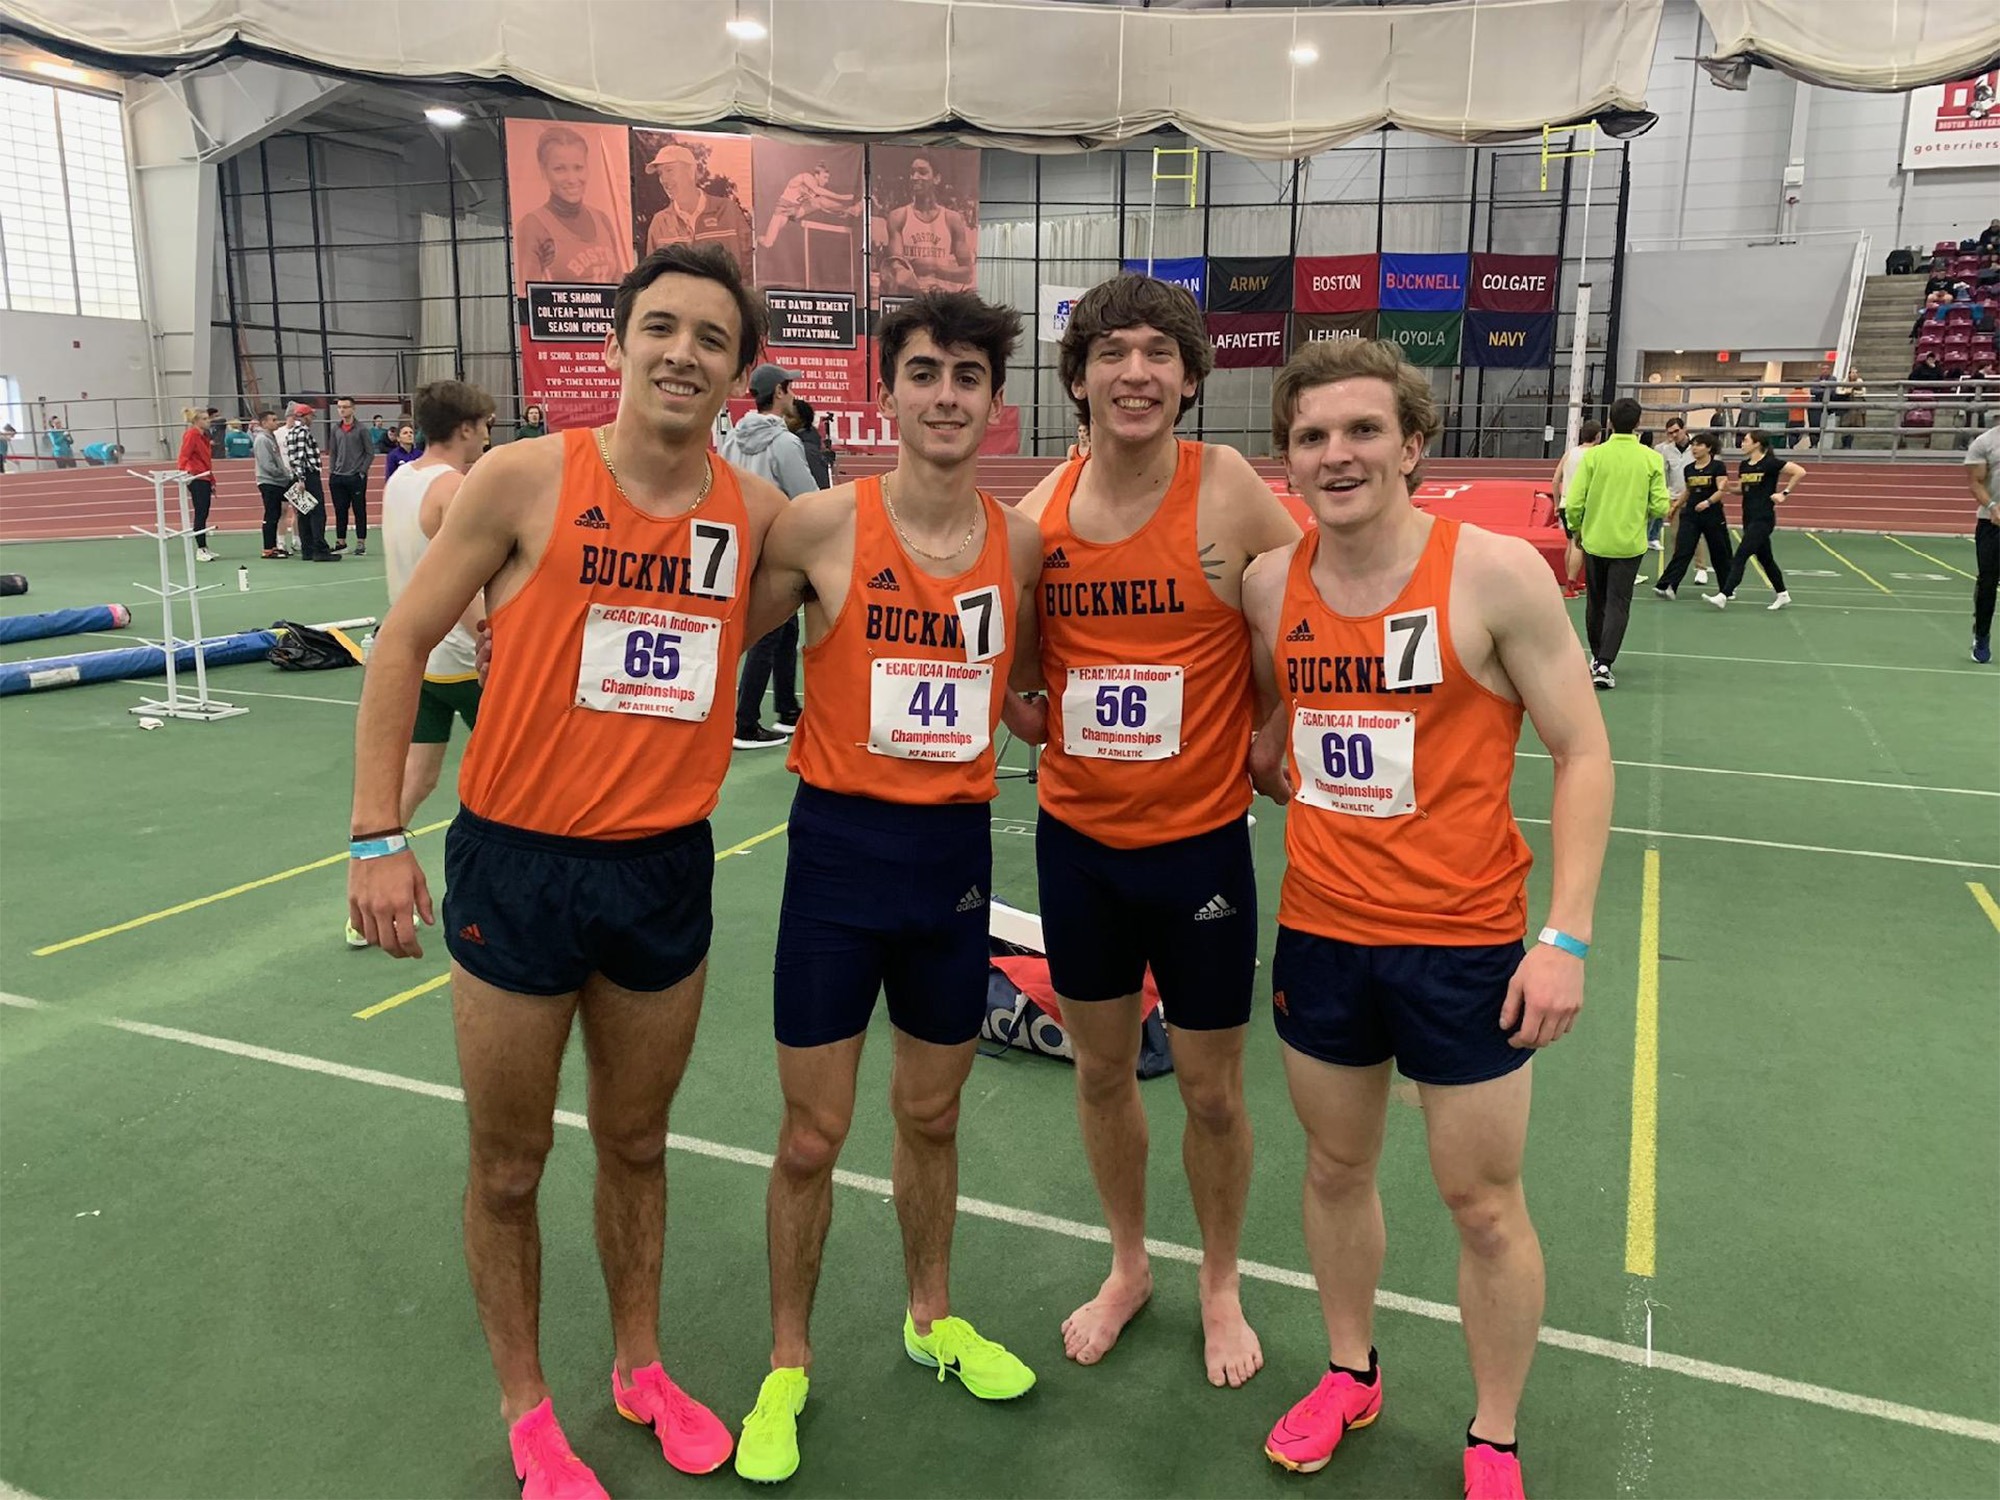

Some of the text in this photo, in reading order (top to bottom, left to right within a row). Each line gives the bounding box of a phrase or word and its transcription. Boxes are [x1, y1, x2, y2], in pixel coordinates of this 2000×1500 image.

[1229, 276, 1269, 291] ARMY
[1312, 274, 1361, 291] BOSTON
[1386, 273, 1461, 289] BUCKNELL
[1482, 273, 1547, 291] COLGATE
[551, 292, 602, 304] THE SHARON
[770, 299, 849, 312] THE DAVID HEMERY
[537, 307, 615, 319] COLYEAR-DANVILLE
[787, 314, 833, 325] VALENTINE
[548, 321, 612, 333] SEASON OPENER
[782, 328, 840, 339] INVITATIONAL
[1309, 328, 1360, 342] LEHIGH
[1209, 331, 1281, 349] LAFAYETTE
[1391, 330, 1446, 346] LOYOLA
[1488, 331, 1526, 347] NAVY
[550, 351, 573, 360] SCHOOL
[575, 351, 600, 360] RECORD
[776, 356, 848, 367] WORLD RECORD HOLDER
[559, 365, 606, 373] ALL-AMERICAN
[546, 378, 620, 386] TWO-TIME OLYMPIAN
[574, 517, 611, 530] adidas
[696, 524, 730, 589] 7
[1043, 560, 1070, 569] adidas
[579, 544, 728, 602] BUCKNE
[867, 581, 900, 592] adidas
[1045, 578, 1185, 617] BUCKNELL
[602, 609, 709, 634] ECAC/IC4A Indoor
[866, 604, 966, 649] BUCKN
[960, 592, 993, 656] 7
[1286, 634, 1315, 642] adidas
[624, 630, 682, 681] 65
[1390, 615, 1428, 682] 7
[886, 662, 982, 680] ECAC/IC4A Indoor
[1079, 668, 1171, 682] ECAC/IC4A Indoor
[1287, 656, 1433, 694] BUCKNE
[601, 678, 696, 702] Championships
[632, 702, 674, 713] ATHLETIC
[908, 681, 959, 727] 44
[1096, 685, 1147, 728] 56
[1302, 711, 1400, 729] ECAC/IC4A Indoor
[891, 729, 972, 745] Championships
[1082, 727, 1162, 744] Championships
[921, 750, 956, 758] ATHLETIC
[1108, 748, 1143, 757] ATHLETIC
[1321, 732, 1375, 780] 60
[1315, 778, 1393, 800] Championships
[1341, 802, 1374, 812] ATHLETIC
[1194, 906, 1237, 921] adidas
